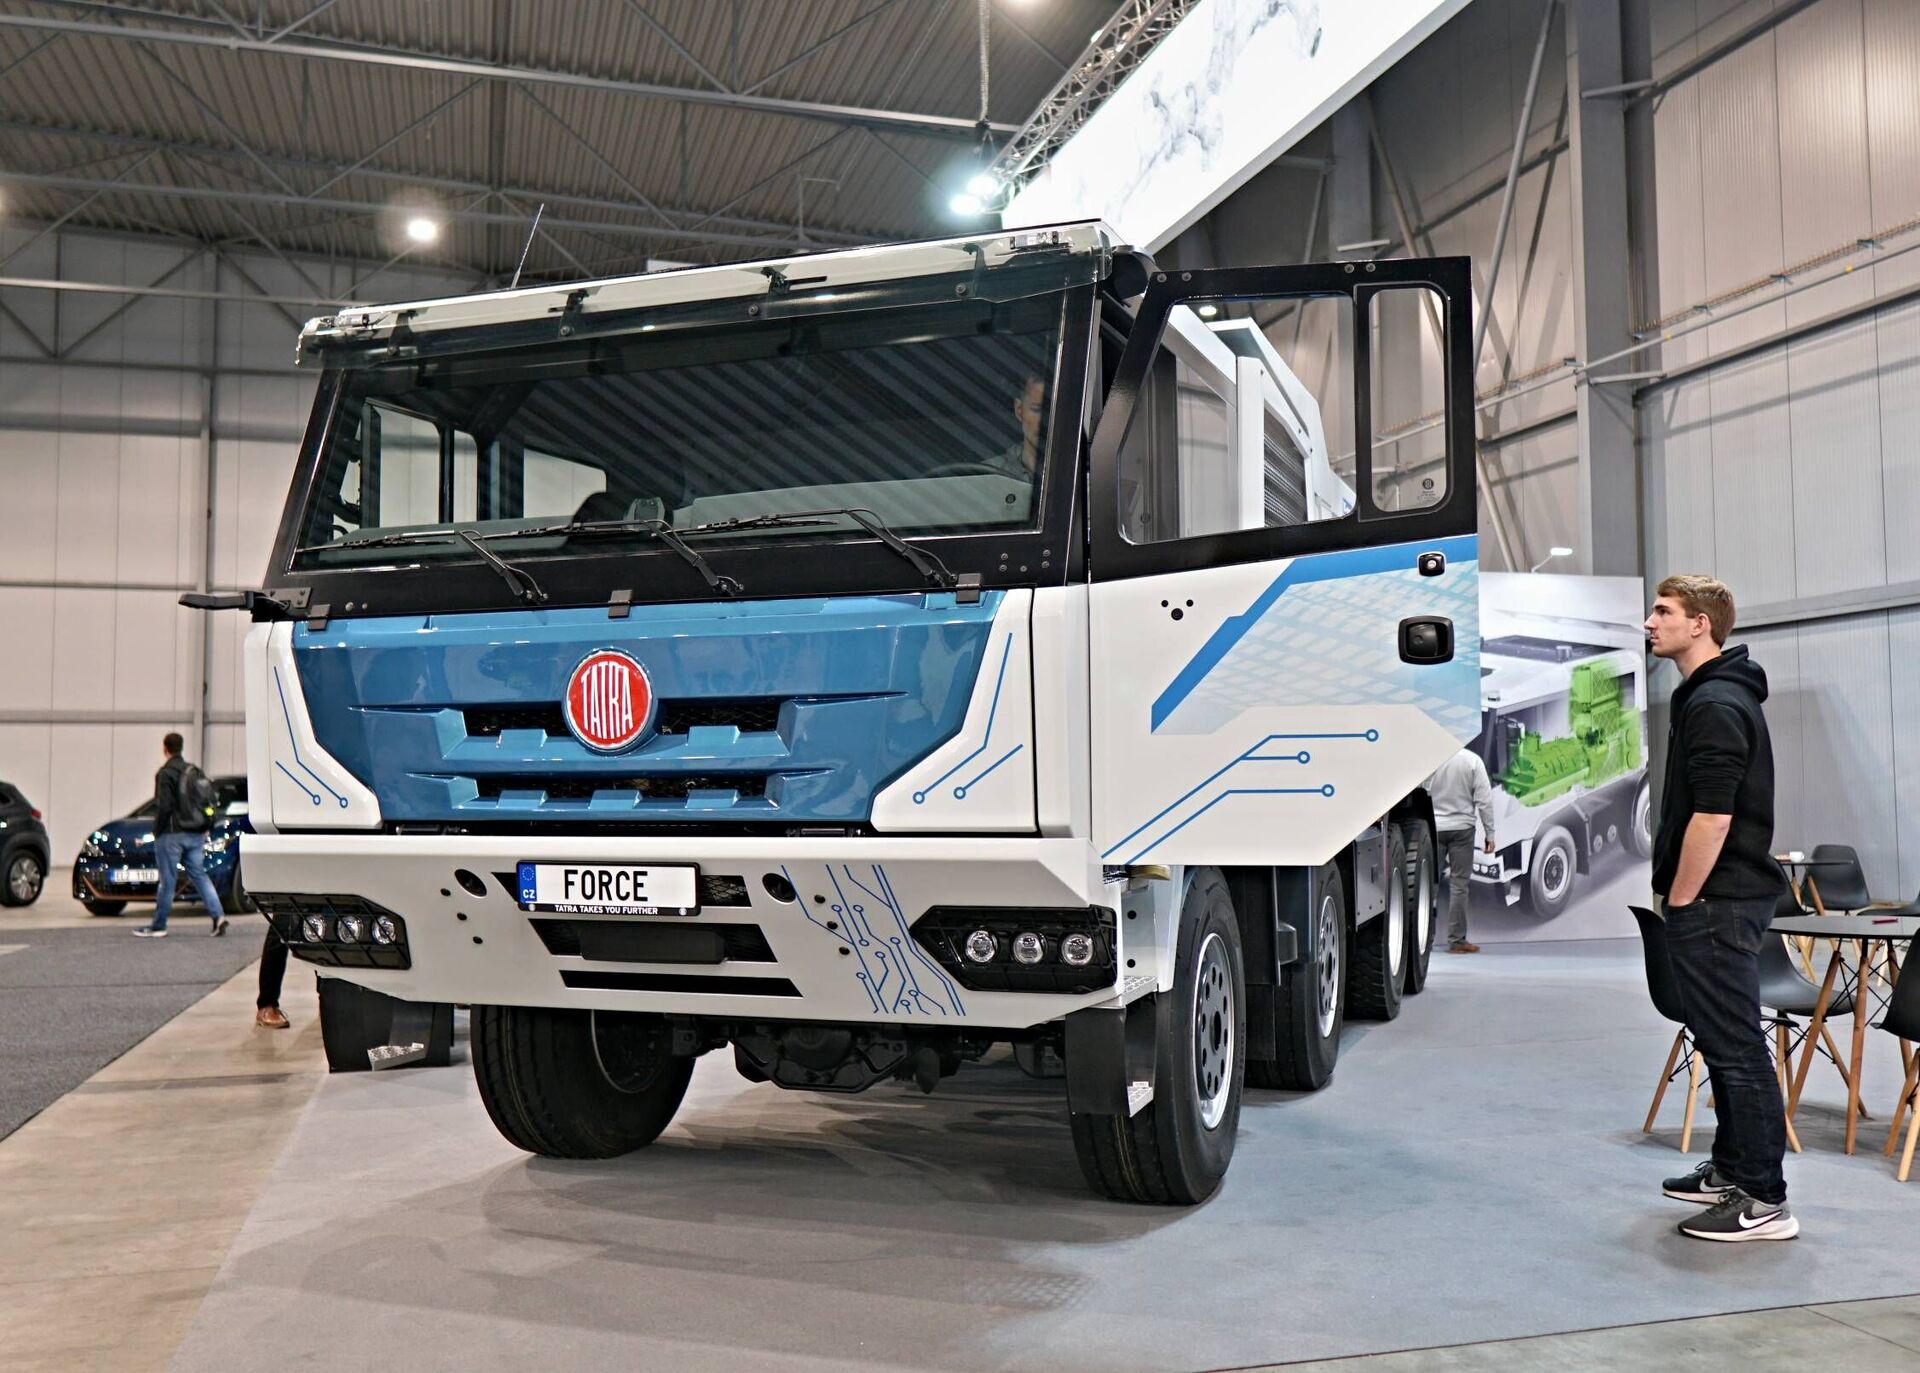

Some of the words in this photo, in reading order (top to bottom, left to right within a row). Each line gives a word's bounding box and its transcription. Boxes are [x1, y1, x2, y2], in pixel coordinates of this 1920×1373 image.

[581, 661, 633, 739] TATRA
[523, 889, 535, 899] CZ
[564, 870, 648, 901] FORCE
[555, 904, 578, 913] TATRA
[580, 906, 603, 914] TAKES
[622, 907, 658, 915] FURTHER
